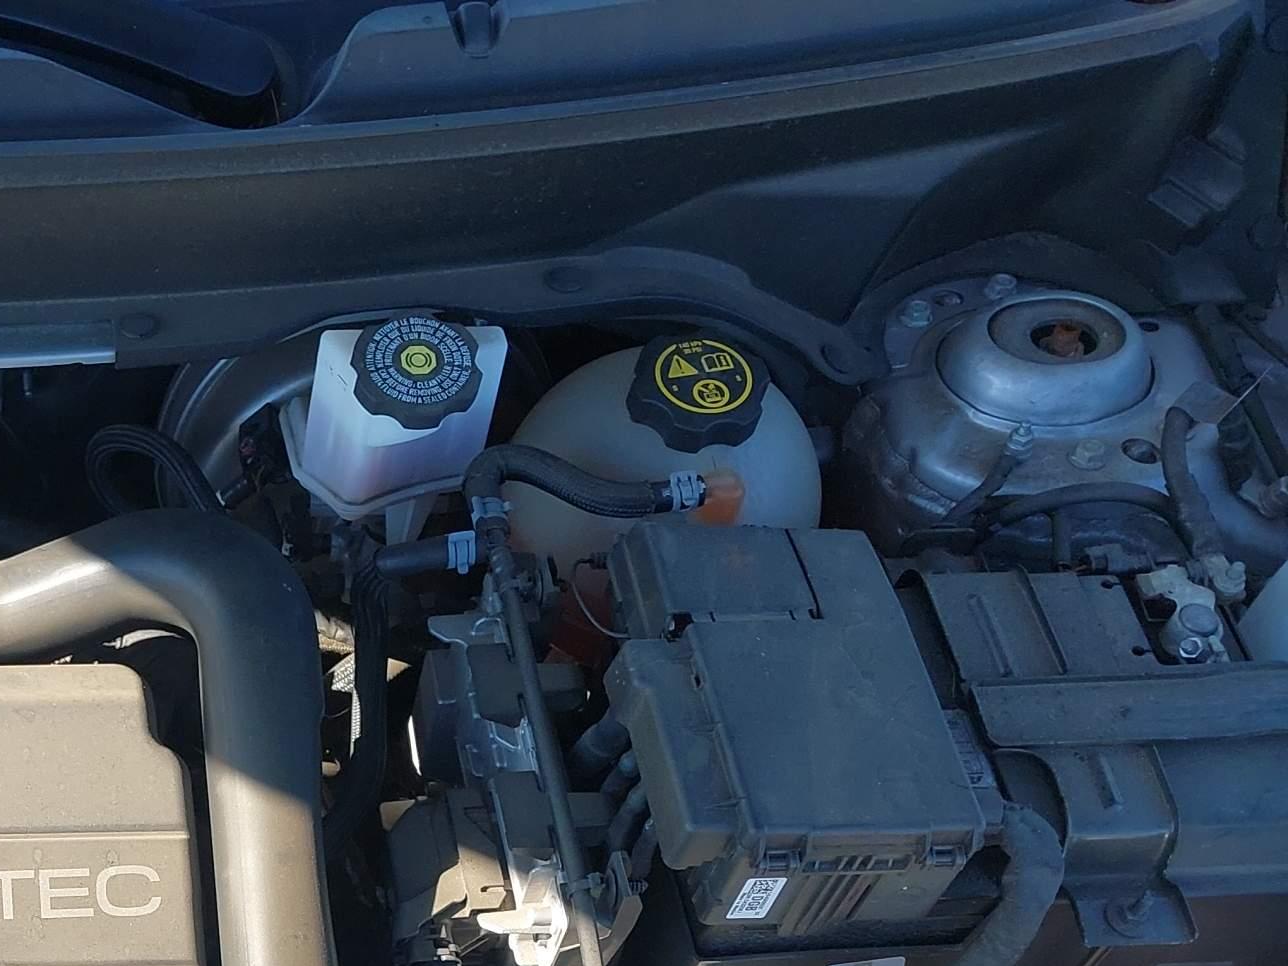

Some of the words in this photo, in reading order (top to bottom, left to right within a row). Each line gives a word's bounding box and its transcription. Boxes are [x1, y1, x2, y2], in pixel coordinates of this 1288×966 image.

[398, 318, 409, 327] LE
[408, 317, 441, 328] BOUCHON
[438, 322, 460, 338] AVANT
[455, 336, 467, 345] LA
[399, 325, 411, 334] DU
[410, 324, 436, 334] LIQUIDE
[378, 369, 390, 380] CAP
[386, 378, 409, 395] BEFORE
[438, 376, 454, 389] USE
[416, 377, 438, 388] CLEAN
[377, 384, 399, 398] FLUID
[396, 392, 417, 403] FROM
[424, 391, 447, 403] SEALED
[744, 896, 764, 910] DGB
